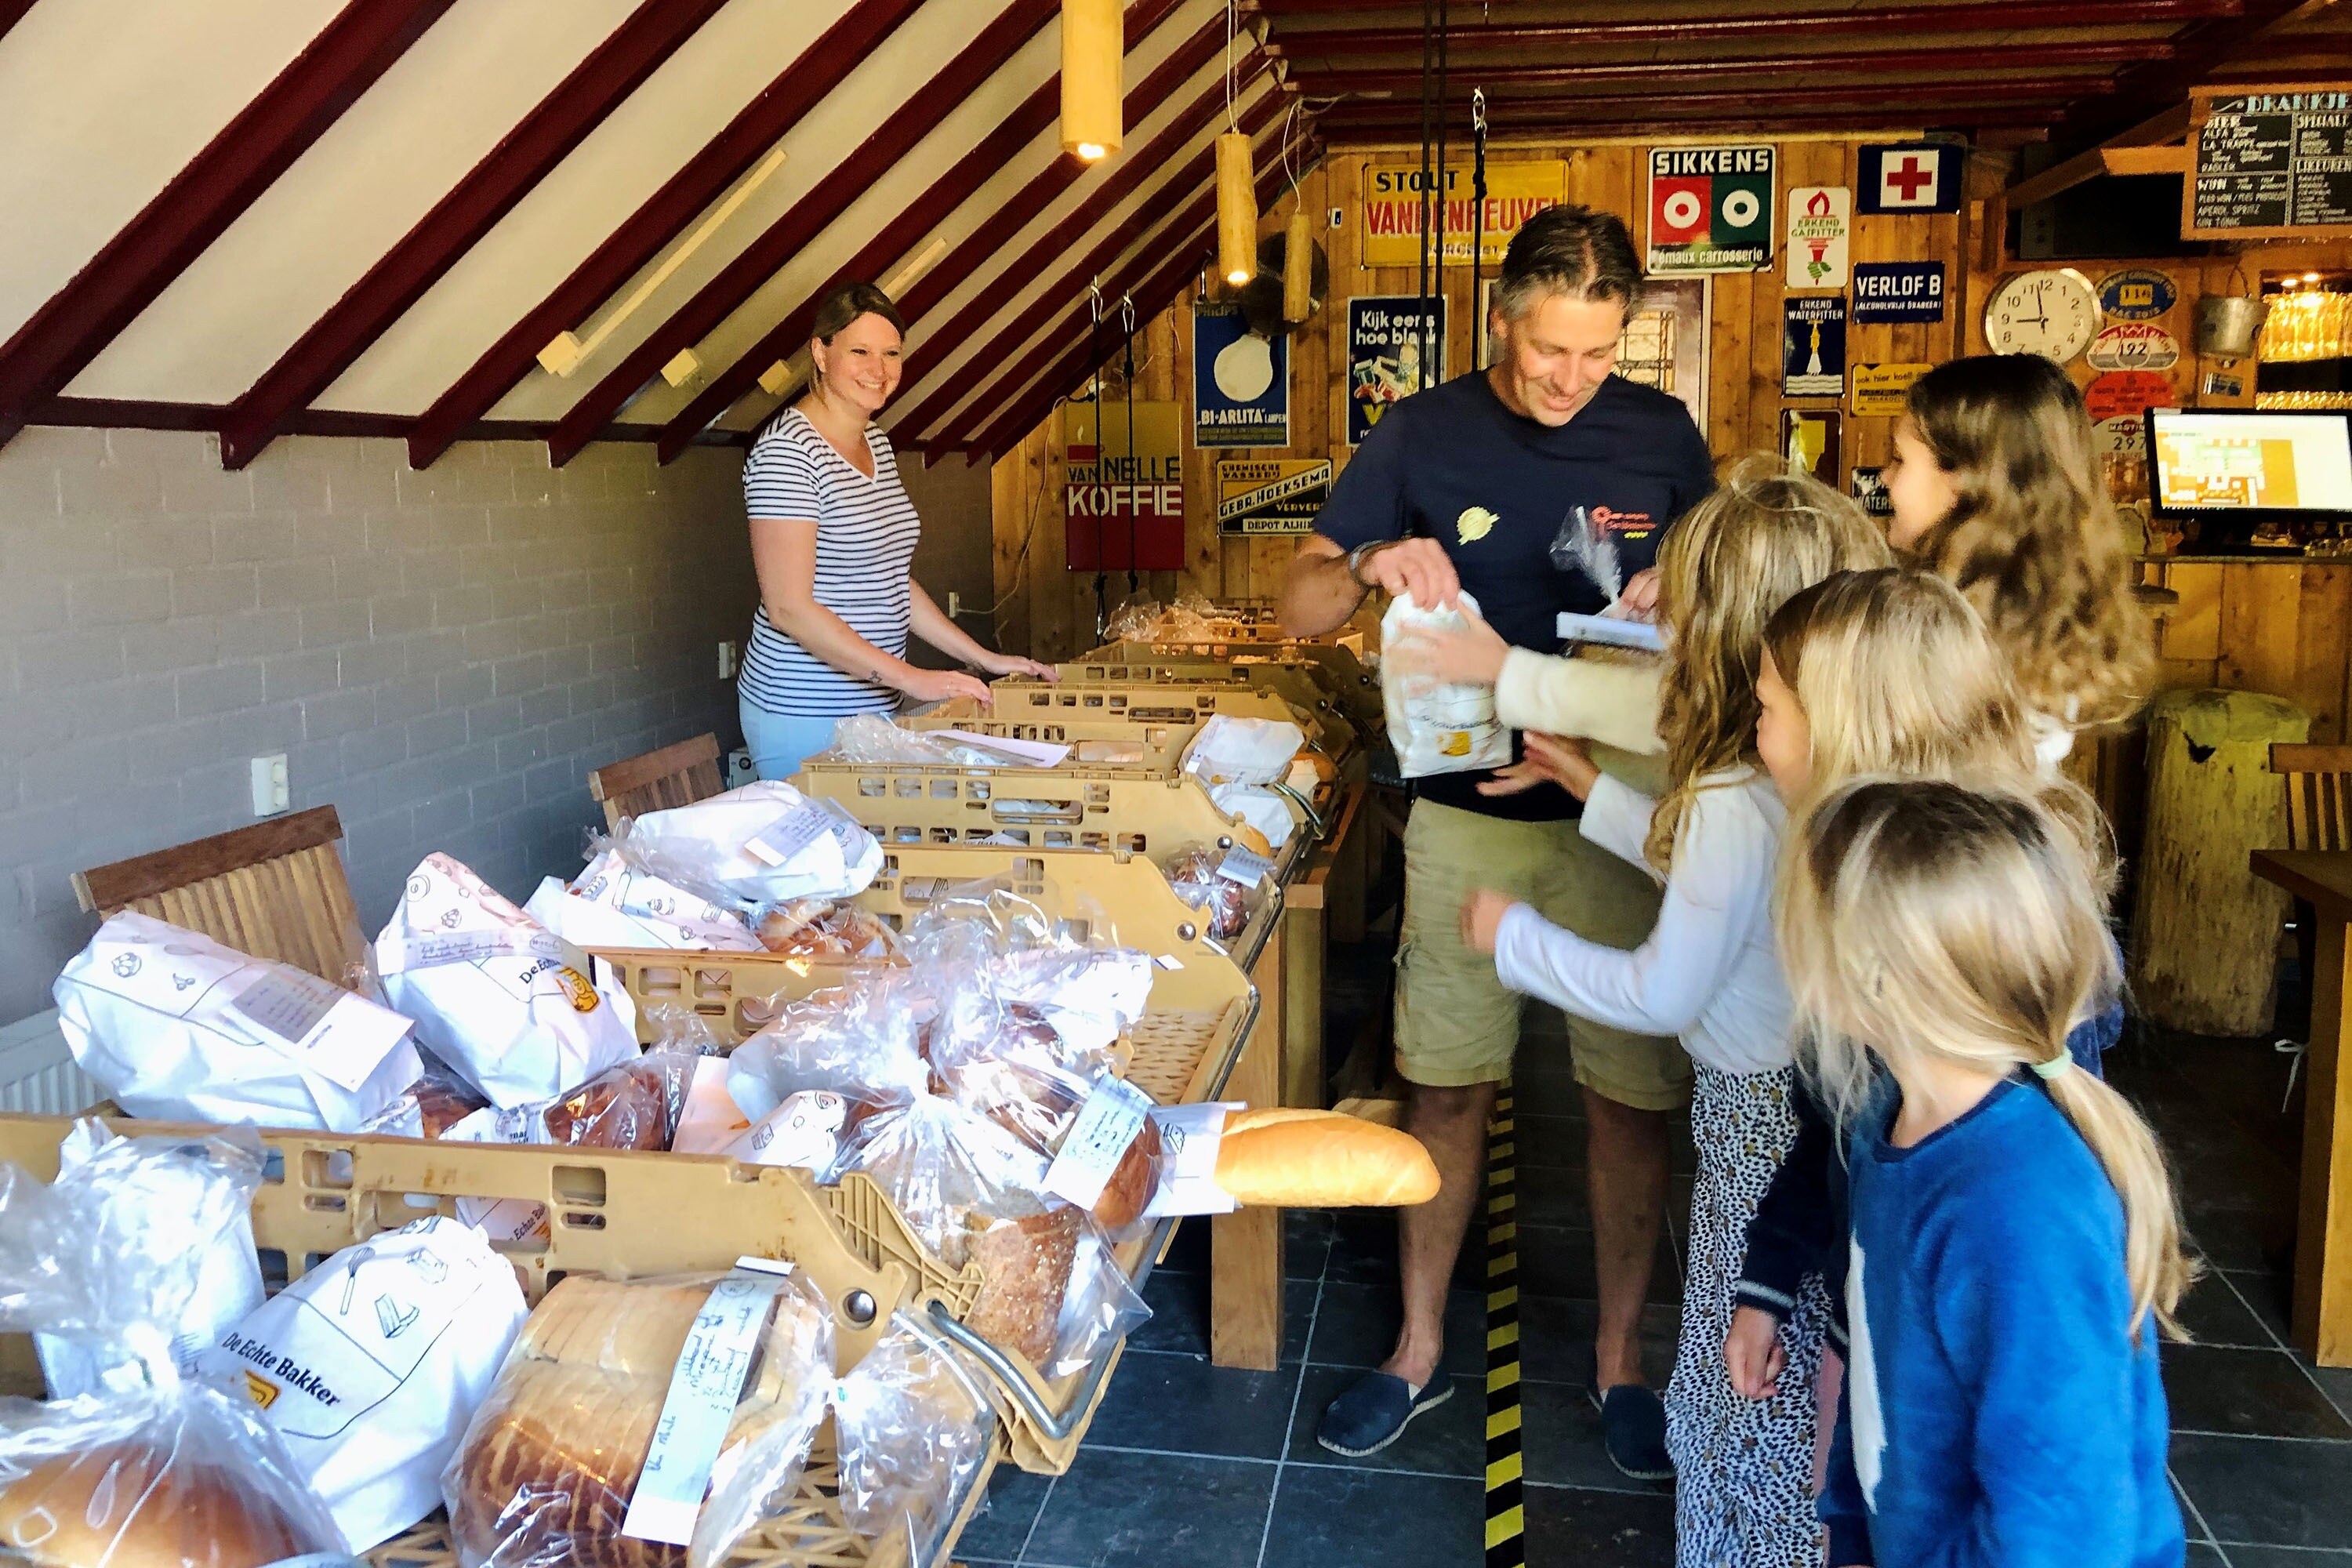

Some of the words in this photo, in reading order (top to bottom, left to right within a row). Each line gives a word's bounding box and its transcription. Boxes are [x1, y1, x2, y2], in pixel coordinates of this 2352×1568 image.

[1655, 149, 1769, 175] SIKKENS
[1376, 170, 1460, 192] STOUT
[1798, 219, 1840, 227] ERKEND
[1699, 247, 1763, 263] carrosserie
[1856, 274, 1924, 297] VERLOF
[1929, 274, 1941, 296] B
[1799, 299, 1832, 309] ERKEND
[2007, 295, 2021, 307] 10
[2071, 297, 2080, 310] 2
[1361, 310, 1389, 332] Kijk
[2001, 313, 2010, 325] 9
[1356, 327, 1388, 345] hoe
[1068, 466, 1099, 482] VAN
[1103, 456, 1181, 482] NELLE
[1256, 468, 1330, 504] HOEKSEMA
[1068, 485, 1182, 517] KOFFIE
[1247, 521, 1280, 530] DEPOT
[519, 965, 539, 985] De
[222, 1332, 242, 1352] De
[237, 1339, 278, 1369] Echte
[274, 1356, 341, 1406] Bakker
